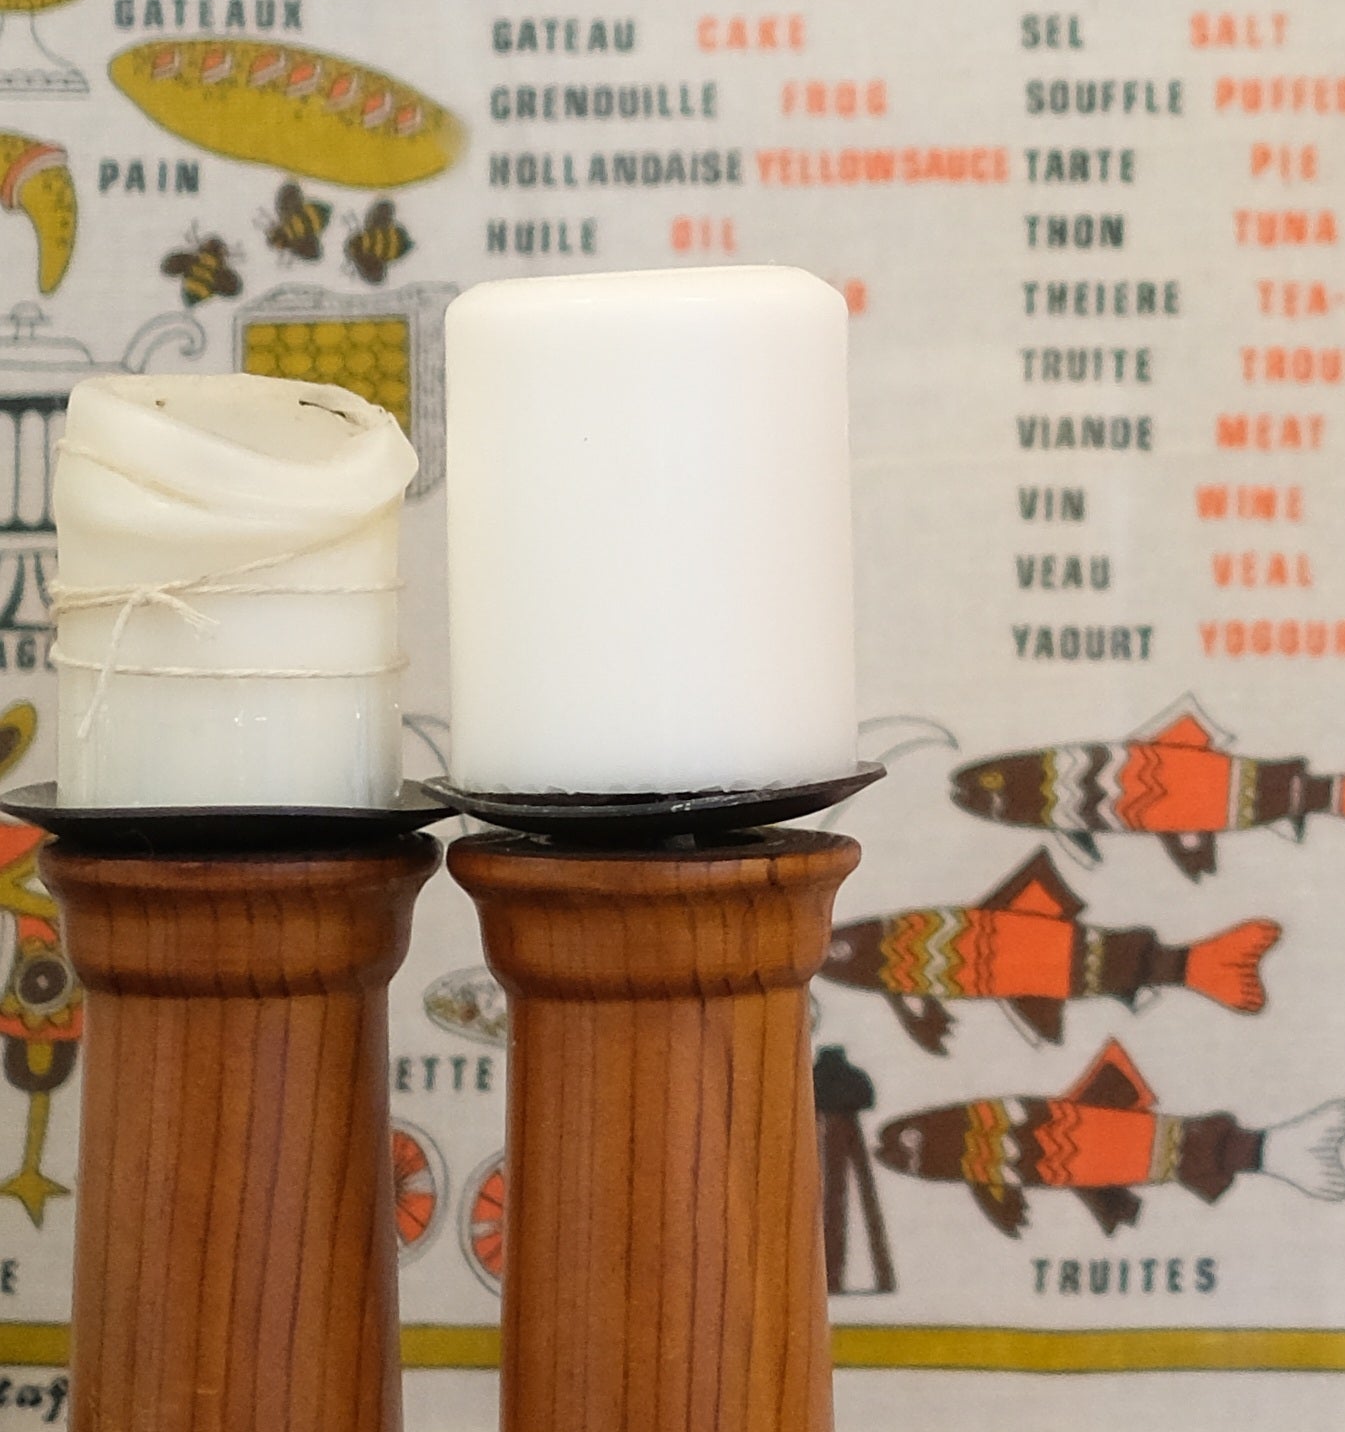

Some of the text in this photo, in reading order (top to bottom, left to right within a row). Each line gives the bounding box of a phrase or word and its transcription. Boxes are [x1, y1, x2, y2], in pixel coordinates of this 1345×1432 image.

[492, 19, 635, 55] GATEAU
[1021, 14, 1084, 50] SEL
[490, 82, 717, 122] GRENOUILLE
[1025, 80, 1182, 116] SOUFFLE
[99, 160, 199, 194] PAIN
[490, 149, 742, 189] HOLLANDAISE
[1025, 149, 1134, 184] TARTE
[487, 219, 596, 258] HUILE
[1025, 214, 1124, 249] THON
[1023, 281, 1179, 316] THEIERE
[1022, 347, 1152, 385] TRUITE
[1016, 416, 1152, 452] VIANDE
[1019, 488, 1085, 522] VIN
[1016, 555, 1110, 591] VEAU
[1012, 625, 1154, 661] YAOURT
[1032, 1257, 1218, 1294] TRUITES
